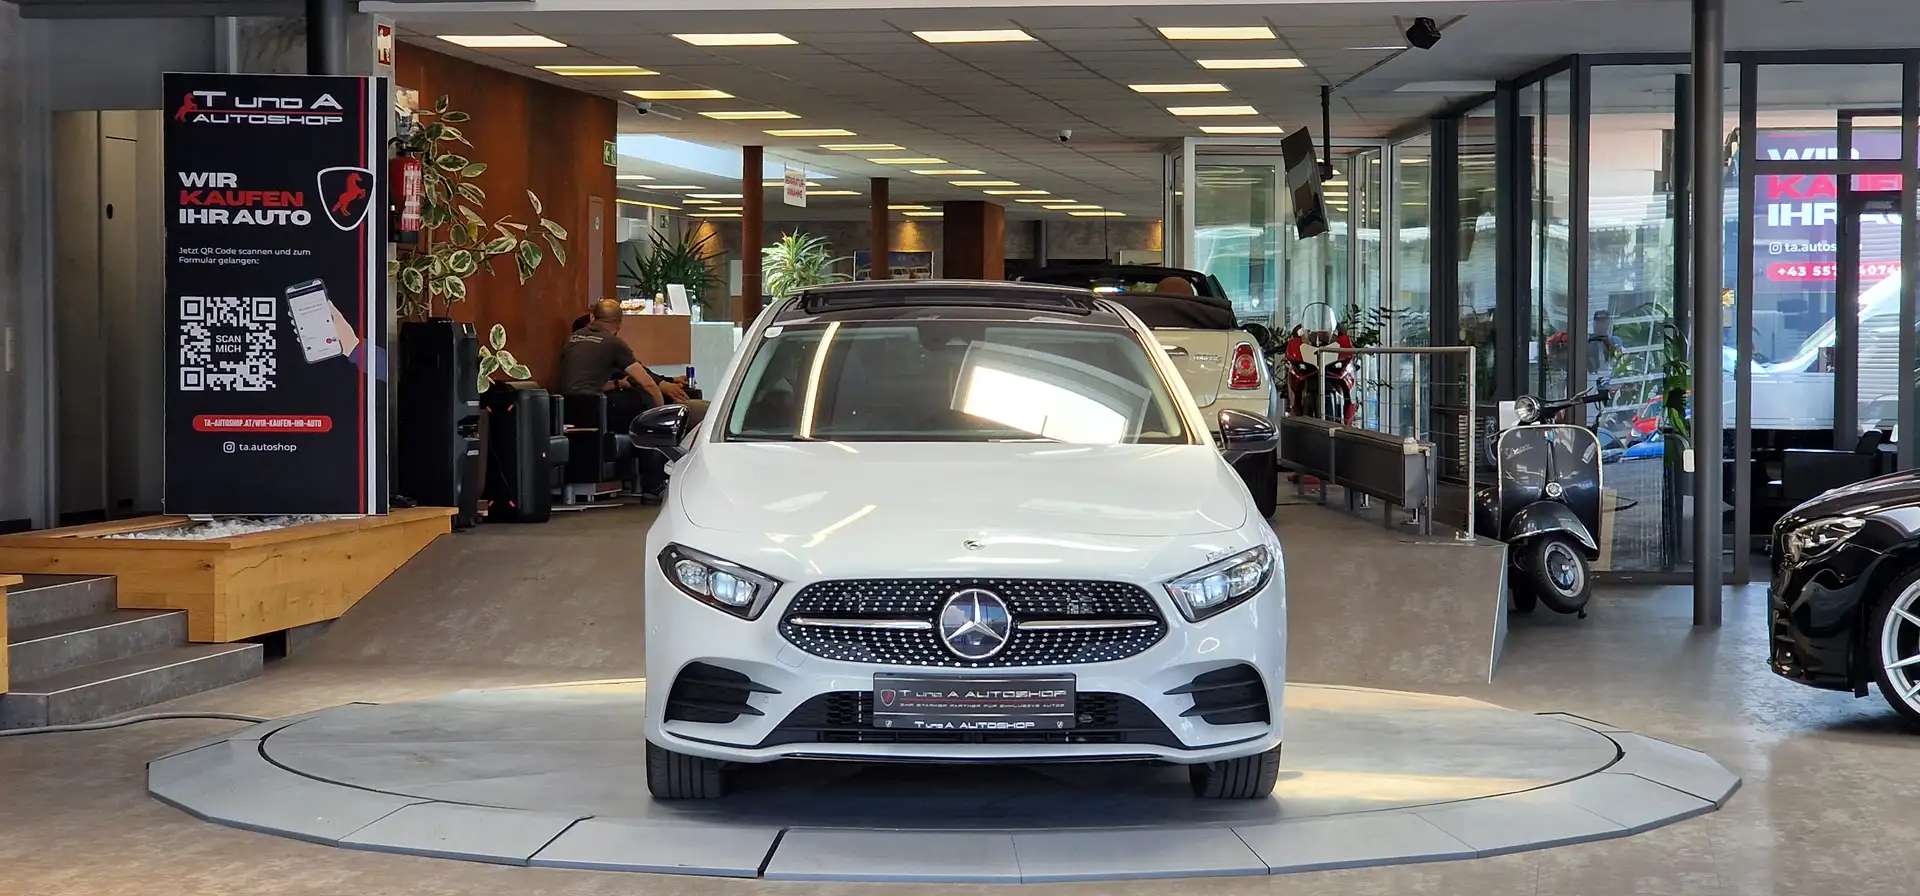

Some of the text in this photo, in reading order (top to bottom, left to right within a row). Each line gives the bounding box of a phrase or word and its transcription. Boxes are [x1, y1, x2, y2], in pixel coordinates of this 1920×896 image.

[193, 90, 227, 107] T
[310, 93, 343, 110] A
[193, 114, 343, 126] AUTOSHOP
[178, 171, 238, 188] WIR
[179, 189, 304, 207] KAUFEN
[179, 208, 312, 226] IHR AUTO
[179, 247, 199, 255] Jetzt
[200, 247, 214, 256] QR
[215, 247, 237, 255] Code
[238, 248, 273, 256] scannen
[274, 248, 291, 256] und
[179, 256, 260, 266] Formular gelangen:
[215, 334, 242, 343] SCAN
[215, 344, 242, 353] MICH
[239, 443, 297, 453] ta.autoshop
[898, 689, 911, 697] T
[947, 690, 959, 698] A
[965, 690, 1067, 698] AUTOSHOP
[959, 721, 1035, 729] AUTOSHOP
